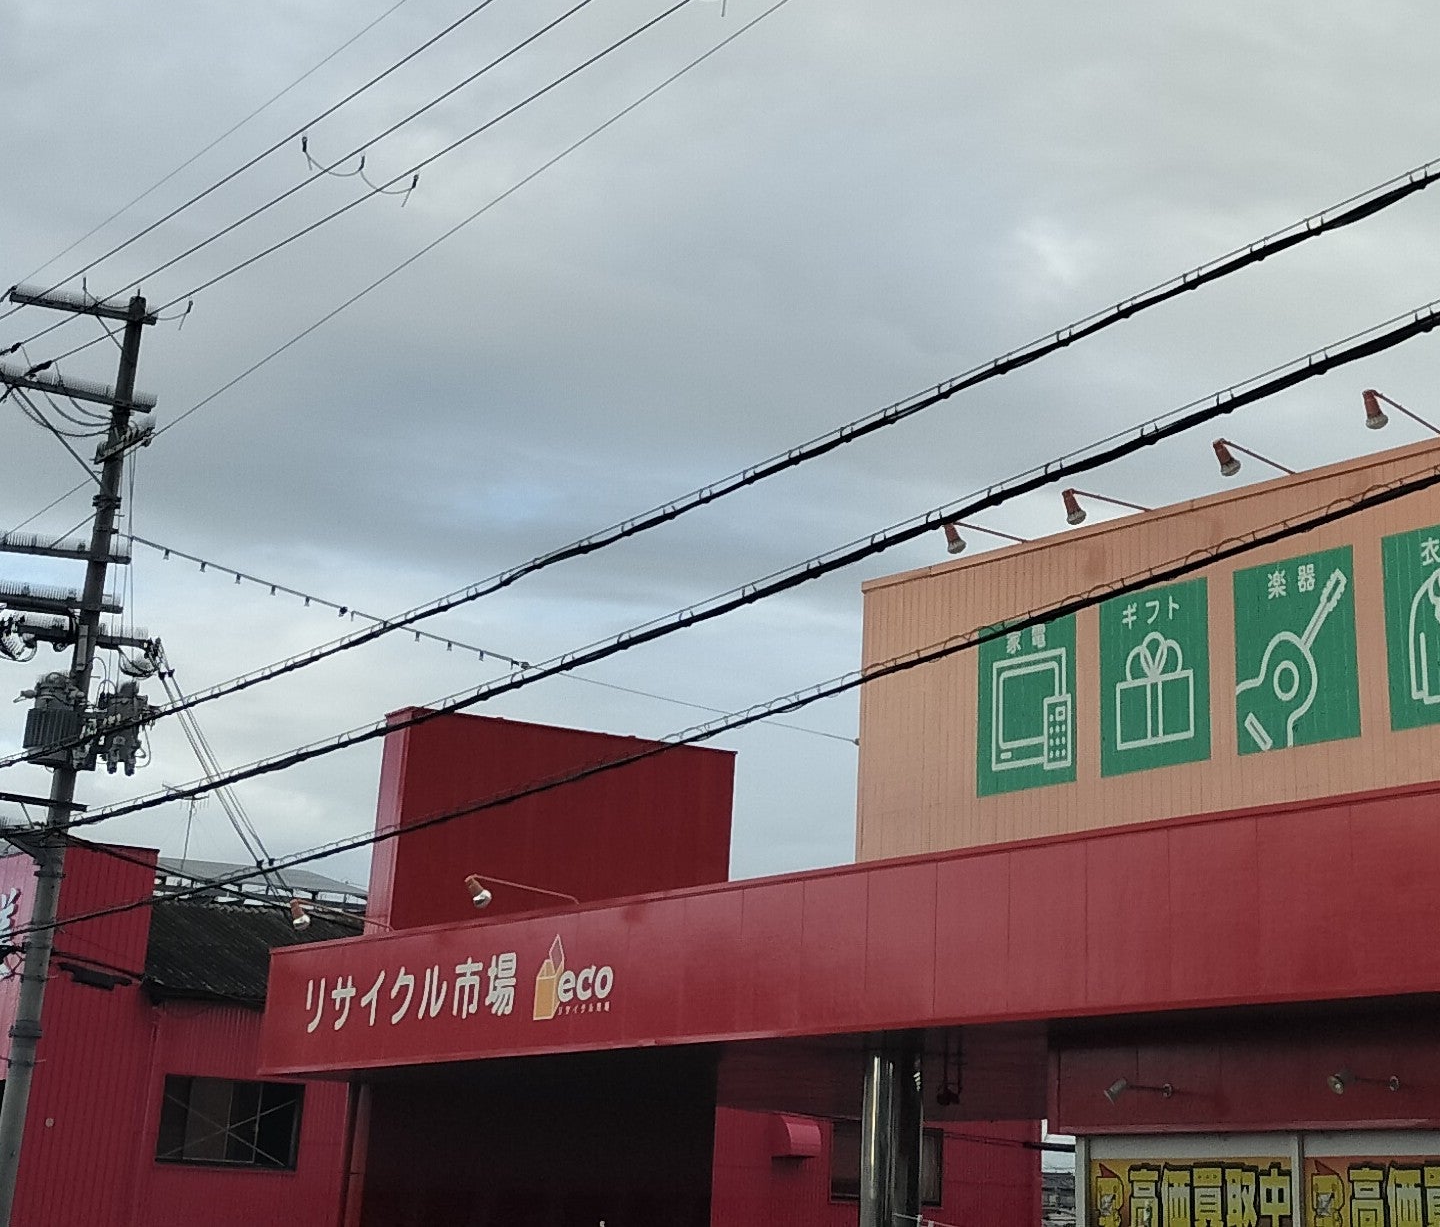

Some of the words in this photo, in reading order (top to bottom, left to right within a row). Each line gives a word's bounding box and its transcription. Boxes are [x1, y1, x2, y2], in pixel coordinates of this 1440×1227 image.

[1267, 563, 1317, 600] 楽器
[1121, 595, 1181, 629] ギフト
[305, 952, 518, 1033] リサイクル市場
[557, 964, 614, 1003] eco
